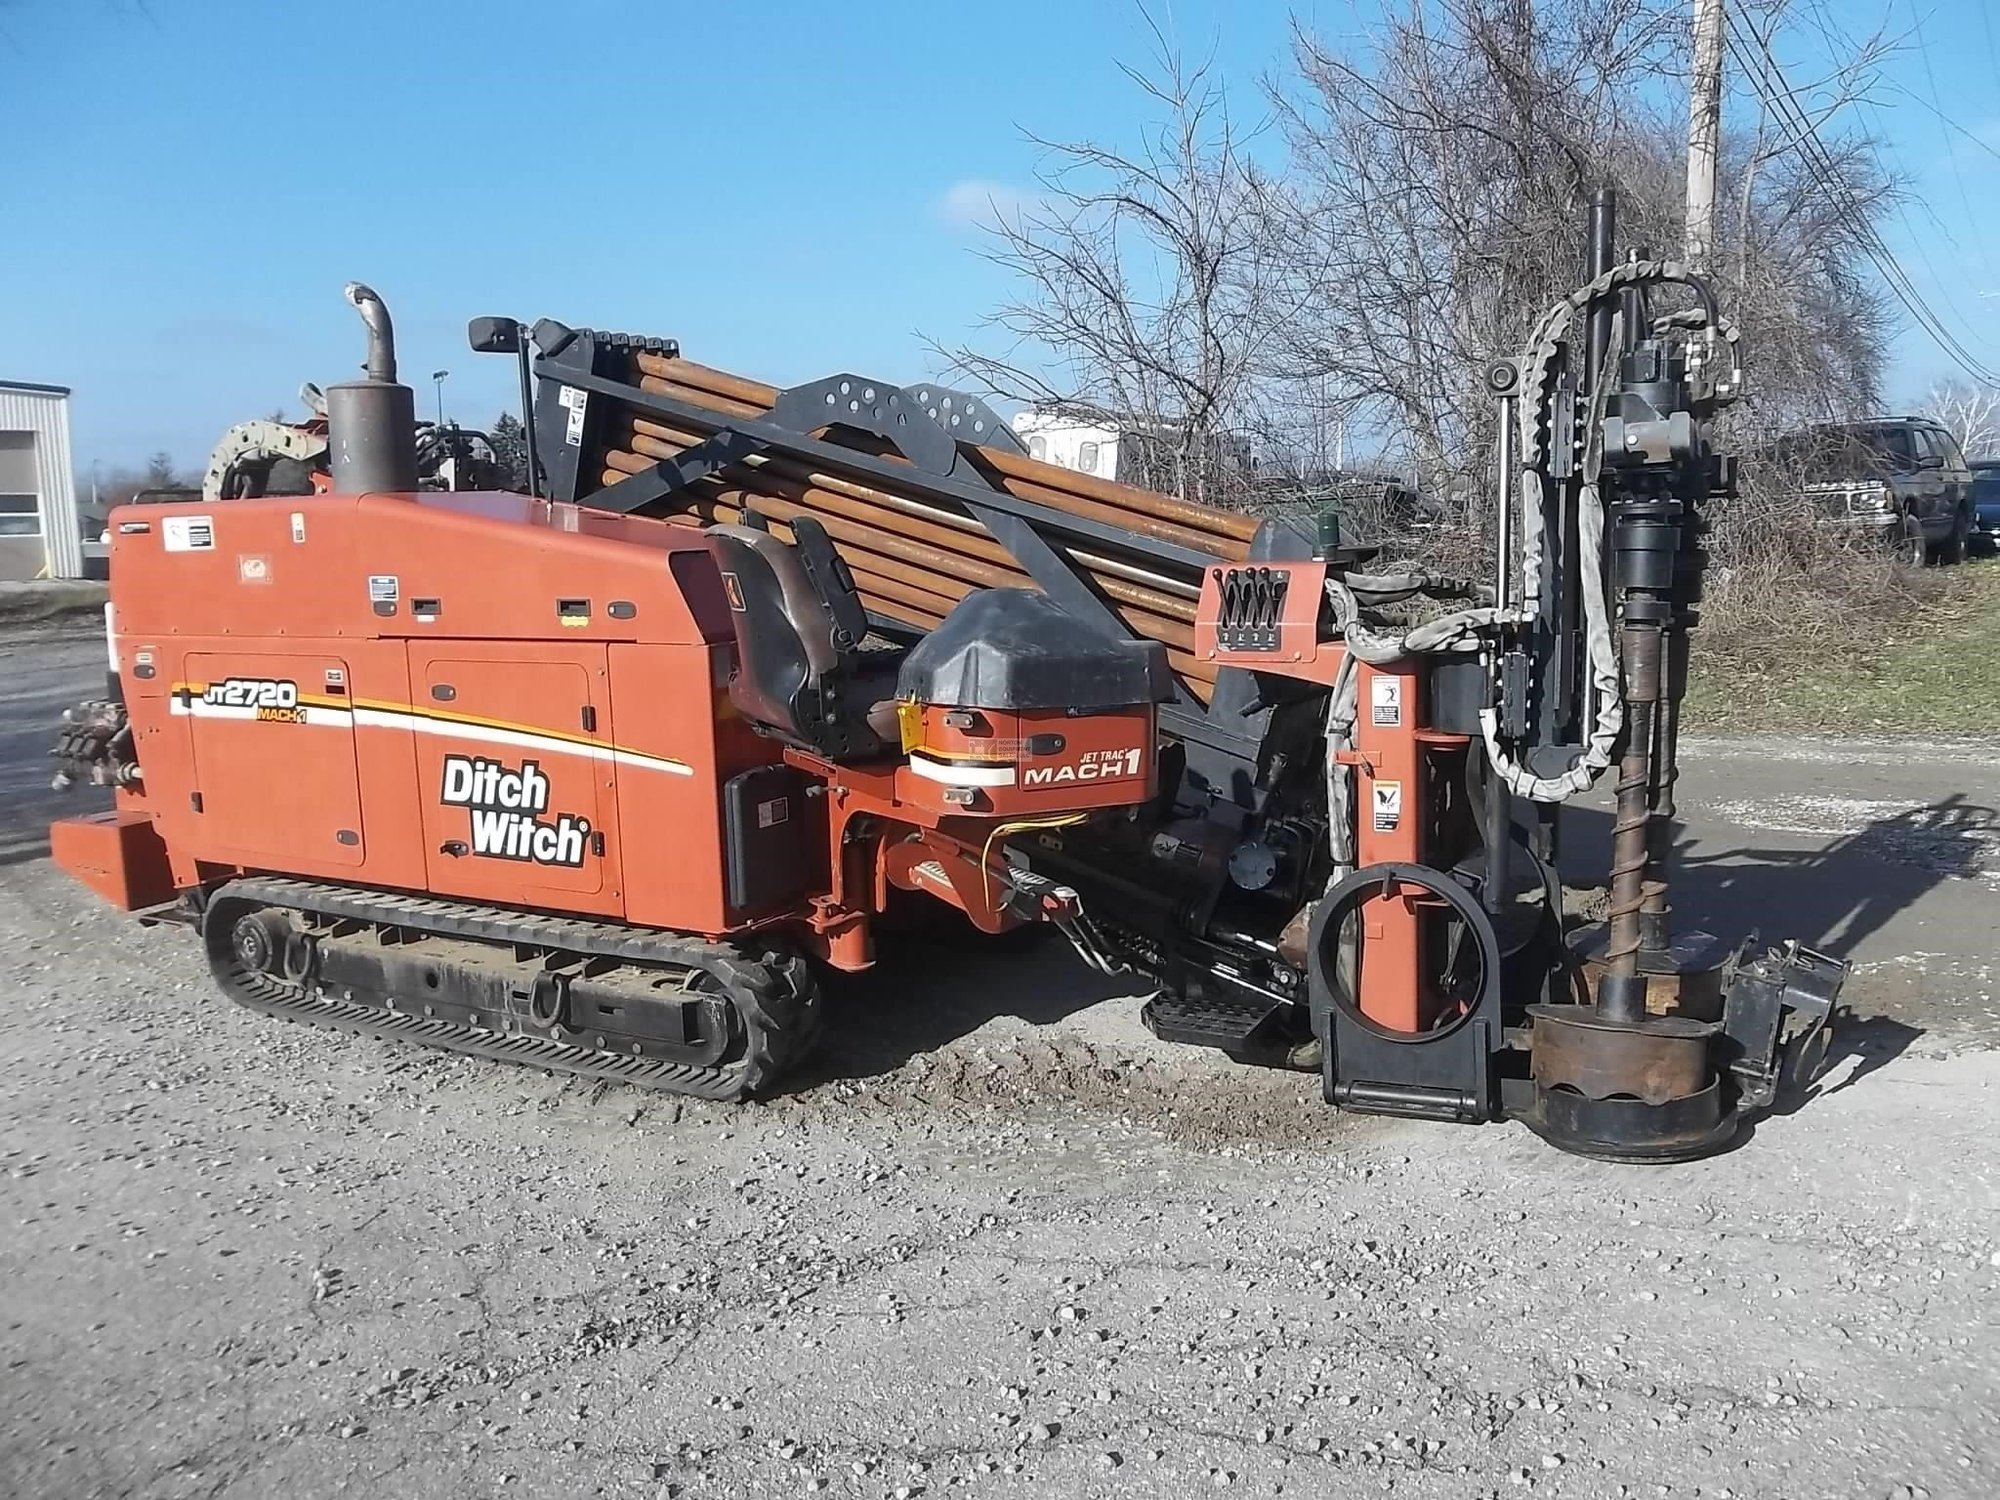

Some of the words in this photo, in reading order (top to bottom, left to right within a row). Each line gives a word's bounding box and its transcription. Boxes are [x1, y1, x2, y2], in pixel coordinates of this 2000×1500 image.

[203, 680, 297, 708] JT2720
[1080, 752, 1098, 764] JET
[1100, 749, 1125, 761] TRAC
[444, 759, 548, 810] Ditch
